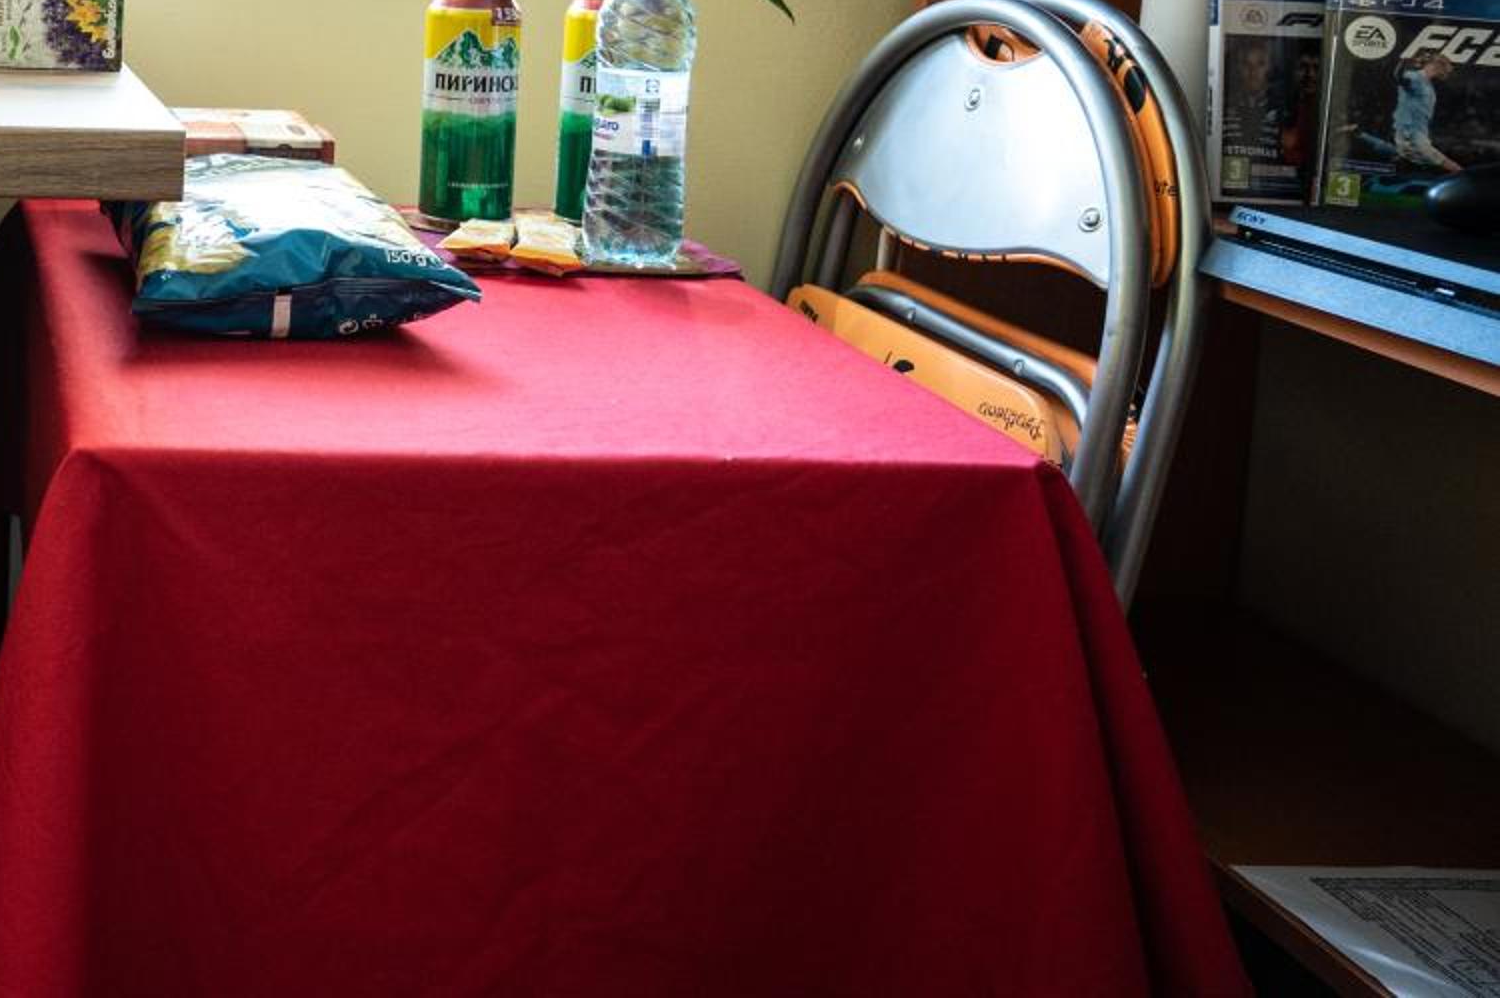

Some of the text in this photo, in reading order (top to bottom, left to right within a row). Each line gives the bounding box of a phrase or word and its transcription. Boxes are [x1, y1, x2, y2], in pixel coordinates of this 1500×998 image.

[1354, 25, 1385, 41] EA
[580, 76, 596, 93] П
[1336, 175, 1351, 196] 3
[1237, 210, 1267, 225] SONY
[387, 249, 412, 263] 150
